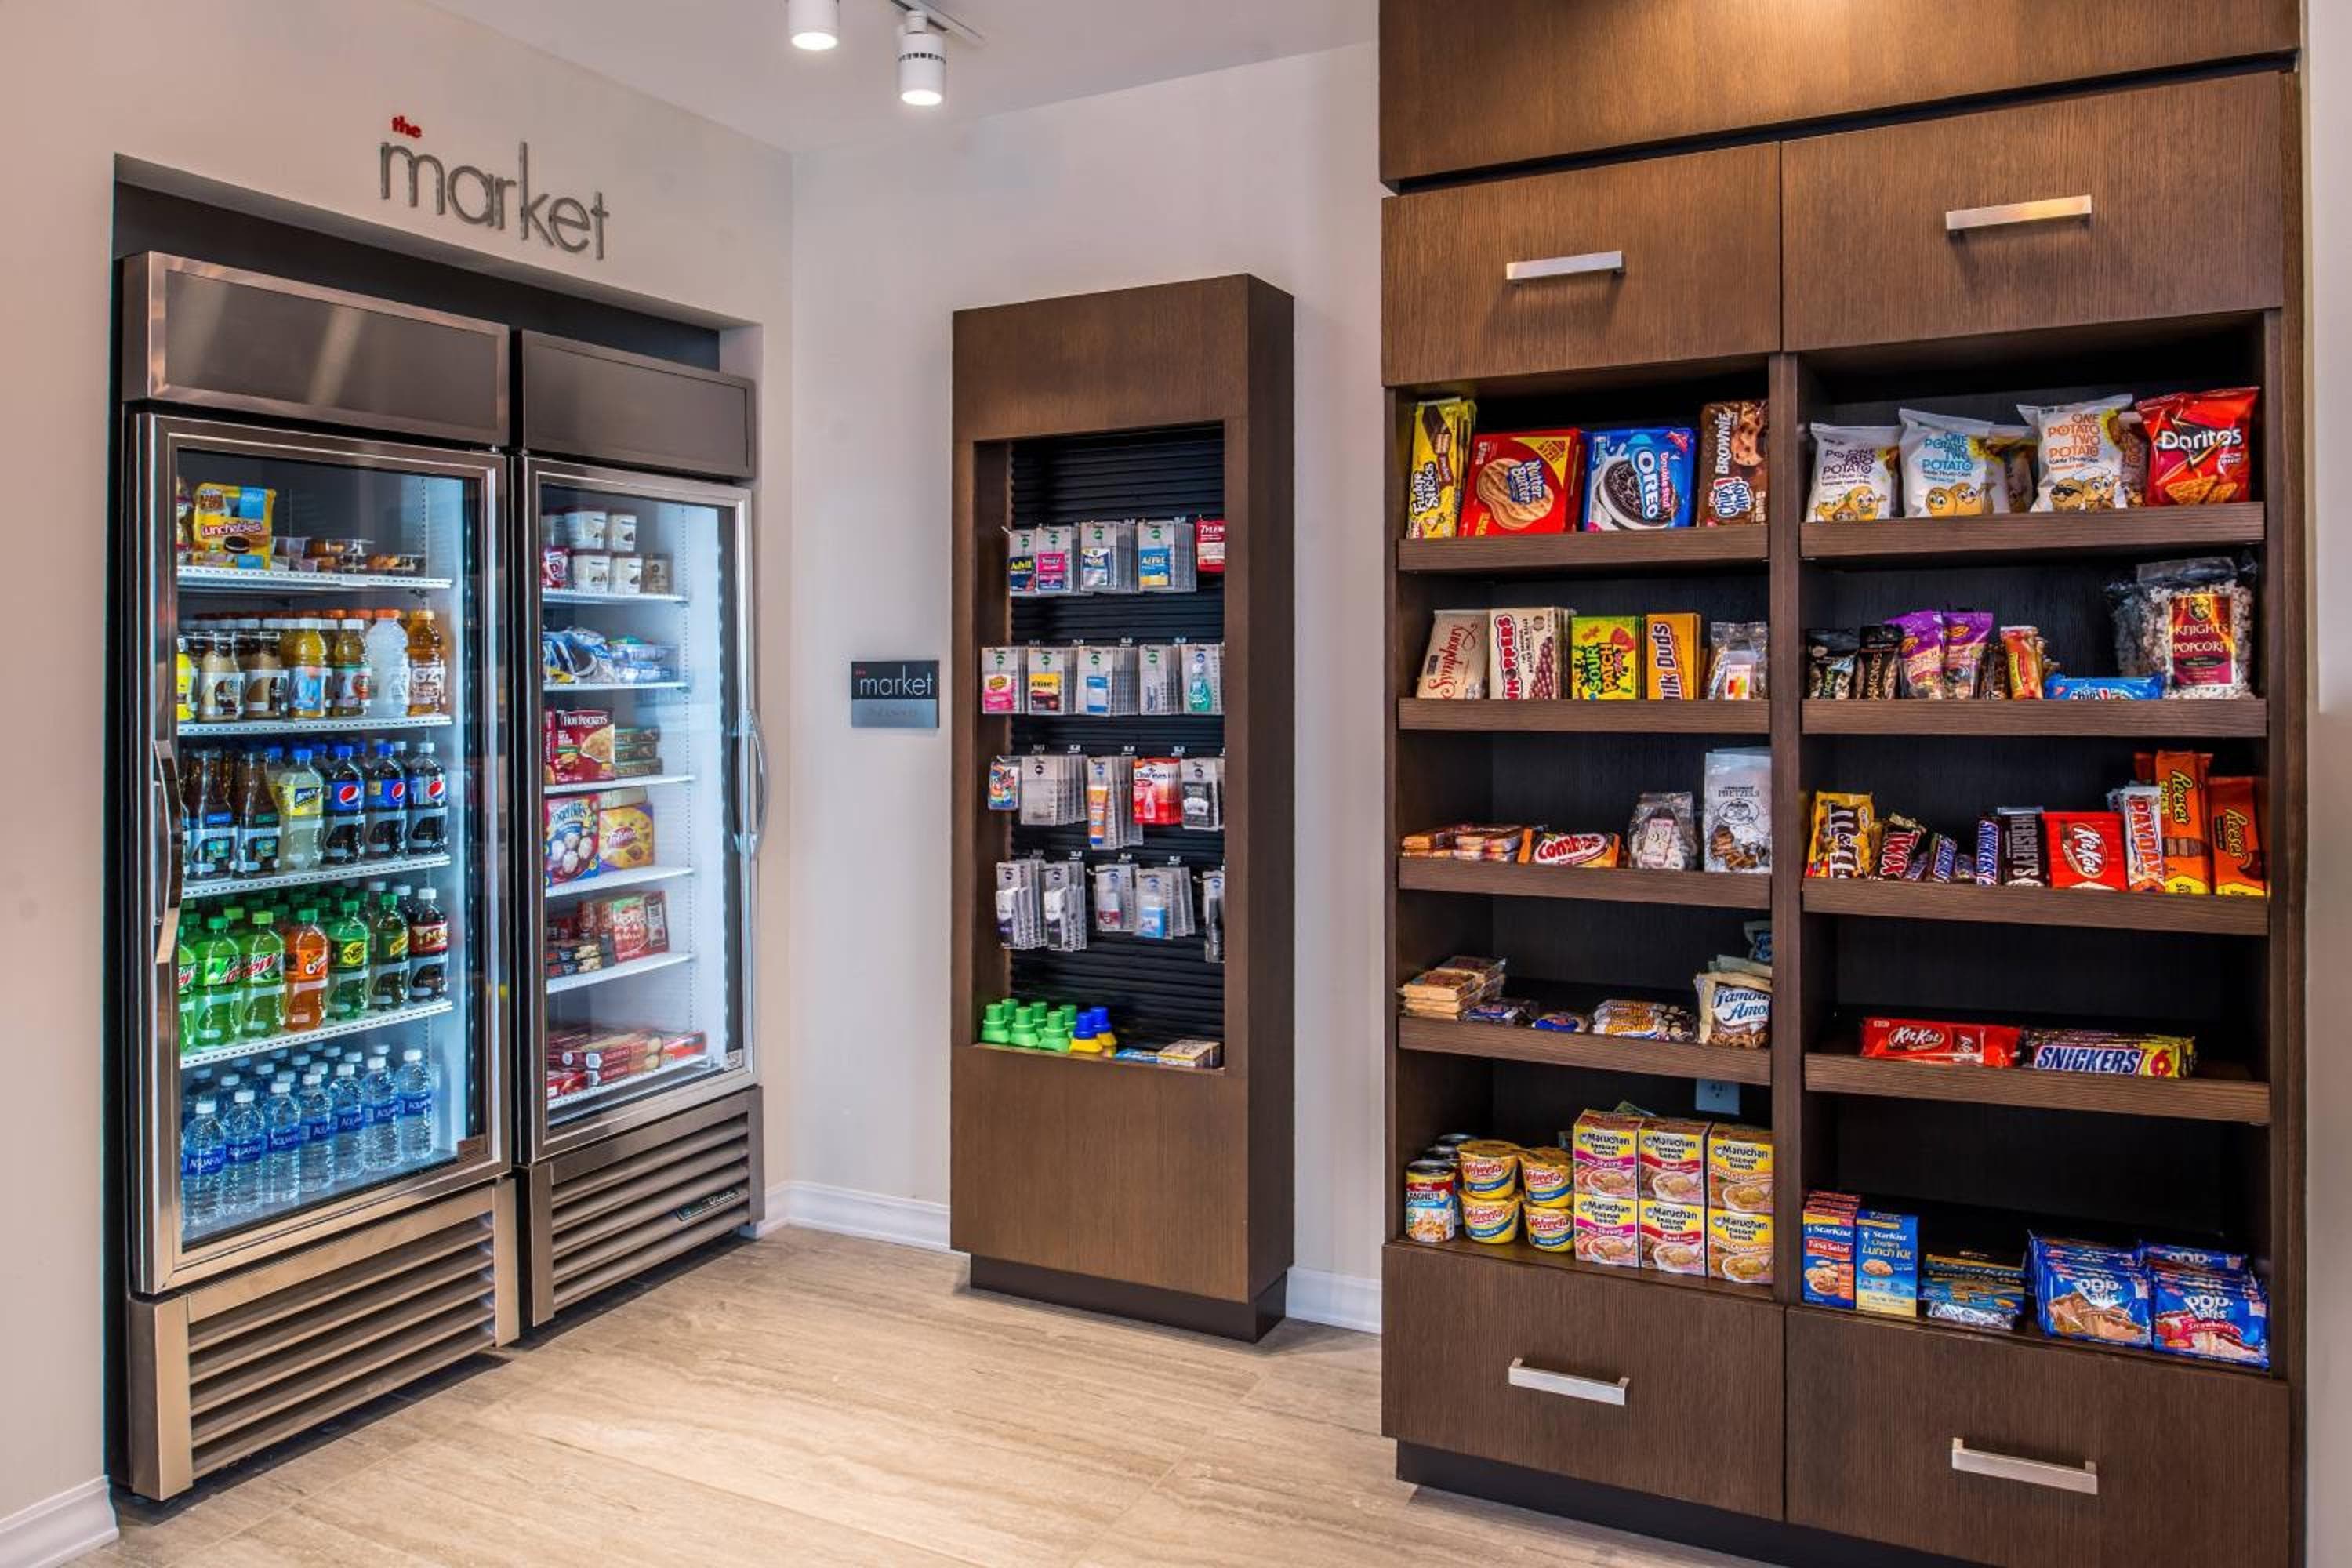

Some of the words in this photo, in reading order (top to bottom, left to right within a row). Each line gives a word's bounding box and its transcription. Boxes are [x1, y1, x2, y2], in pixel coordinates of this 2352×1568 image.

[392, 116, 422, 138] the
[380, 142, 610, 260] market
[2048, 425, 2100, 437] POTATO
[2072, 414, 2100, 424] ONE
[1715, 412, 1733, 474] BROWNIE
[2049, 445, 2099, 458] POTATO
[2074, 435, 2100, 446] TWO
[2160, 428, 2243, 451] Doritos
[1412, 472, 1425, 514] Fudge
[1425, 463, 1439, 509] Sticks
[1511, 466, 1531, 505] Butter
[1526, 459, 1544, 499] Nutter
[1637, 450, 1660, 518] OREO
[1653, 624, 1675, 669] Duds
[860, 664, 933, 695] market
[1586, 647, 1602, 691] SOUR
[1601, 643, 1617, 691] PATCH
[2171, 770, 2193, 825] Reese's
[2011, 815, 2038, 876] HERSHEY'S
[2130, 799, 2162, 877] PAYDAY
[2225, 808, 2248, 858] Reese's
[1880, 831, 1920, 878] TWIX
[1978, 822, 1998, 877] SNICKERS
[2038, 1046, 2140, 1073] SNICKERS
[2149, 1050, 2172, 1076] 6
[1588, 1134, 1630, 1145] Maruchan
[1653, 1136, 1696, 1149] Maruchan
[1723, 1145, 1768, 1159] Maruchan
[1588, 1200, 1631, 1213] Maruchan
[1653, 1207, 1697, 1221] Maruchan
[1723, 1216, 1768, 1230] Maruchan
[1814, 1225, 1853, 1237] StarKist
[1873, 1230, 1907, 1241] StarKist
[1862, 1245, 1896, 1258] Lunch
